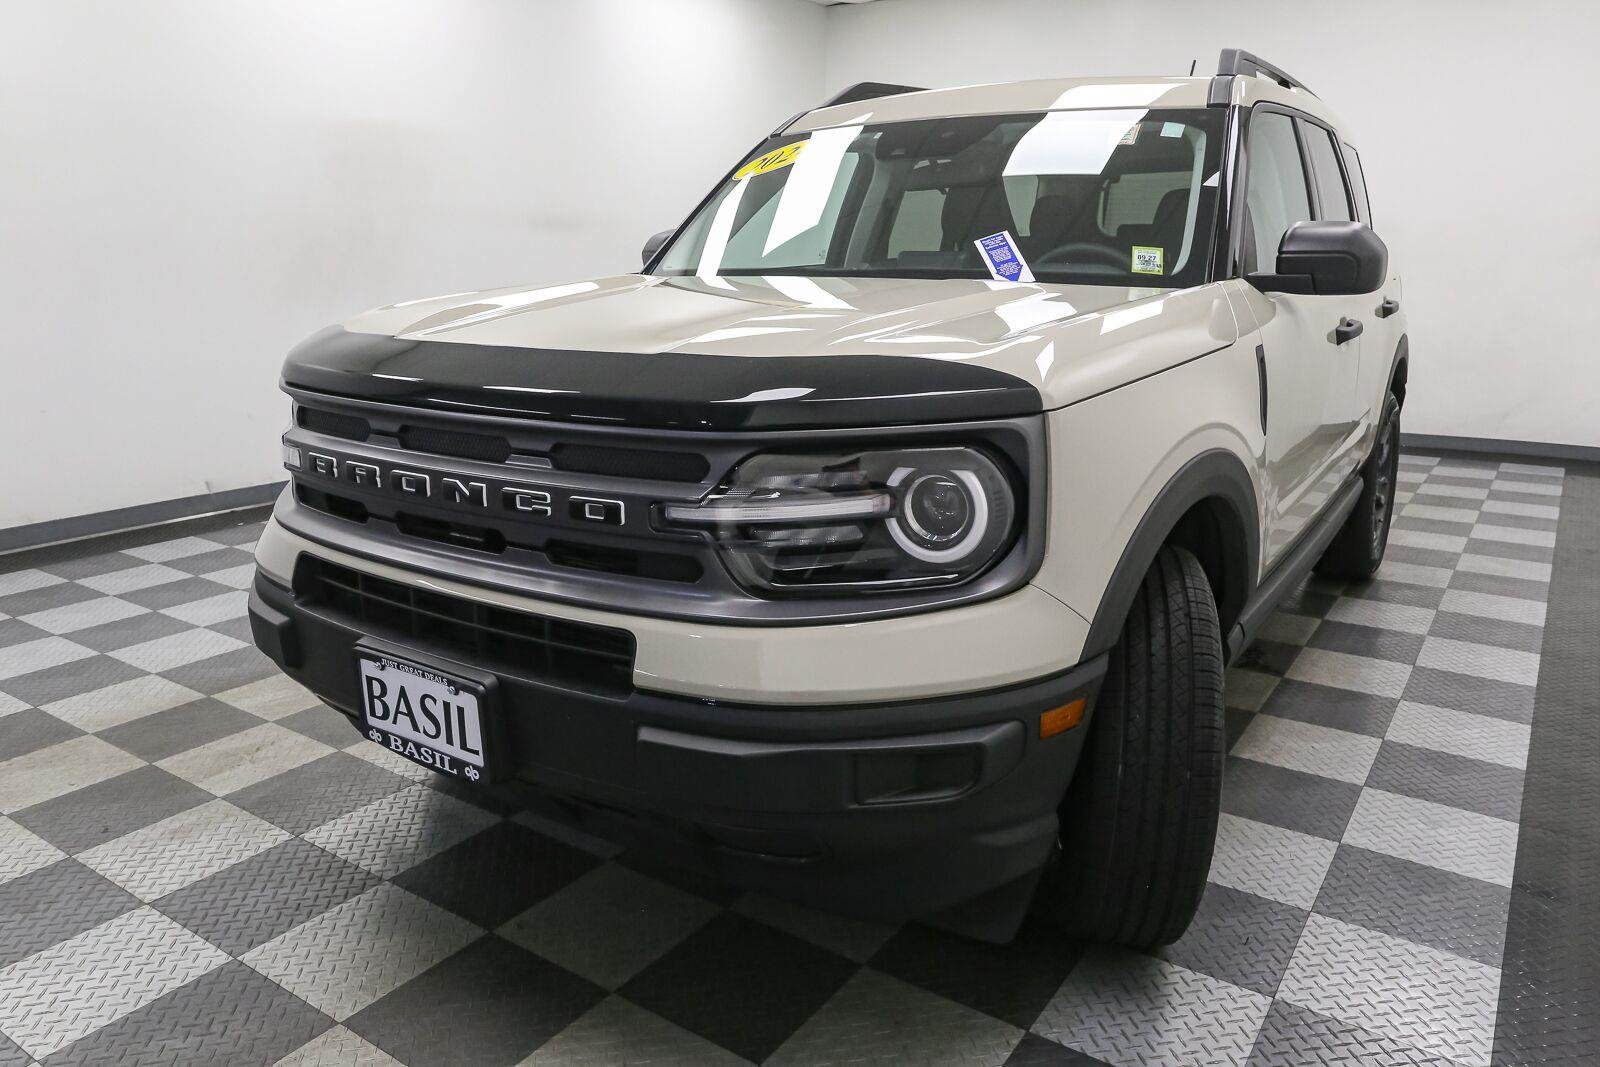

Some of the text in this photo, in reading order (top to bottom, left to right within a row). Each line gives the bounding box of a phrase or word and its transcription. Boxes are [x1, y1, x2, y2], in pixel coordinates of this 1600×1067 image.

[308, 451, 626, 526] BRONCO
[381, 658, 448, 686] JUST GREAT DEALS
[365, 674, 480, 756] BASIL
[388, 734, 458, 775] BASIL
